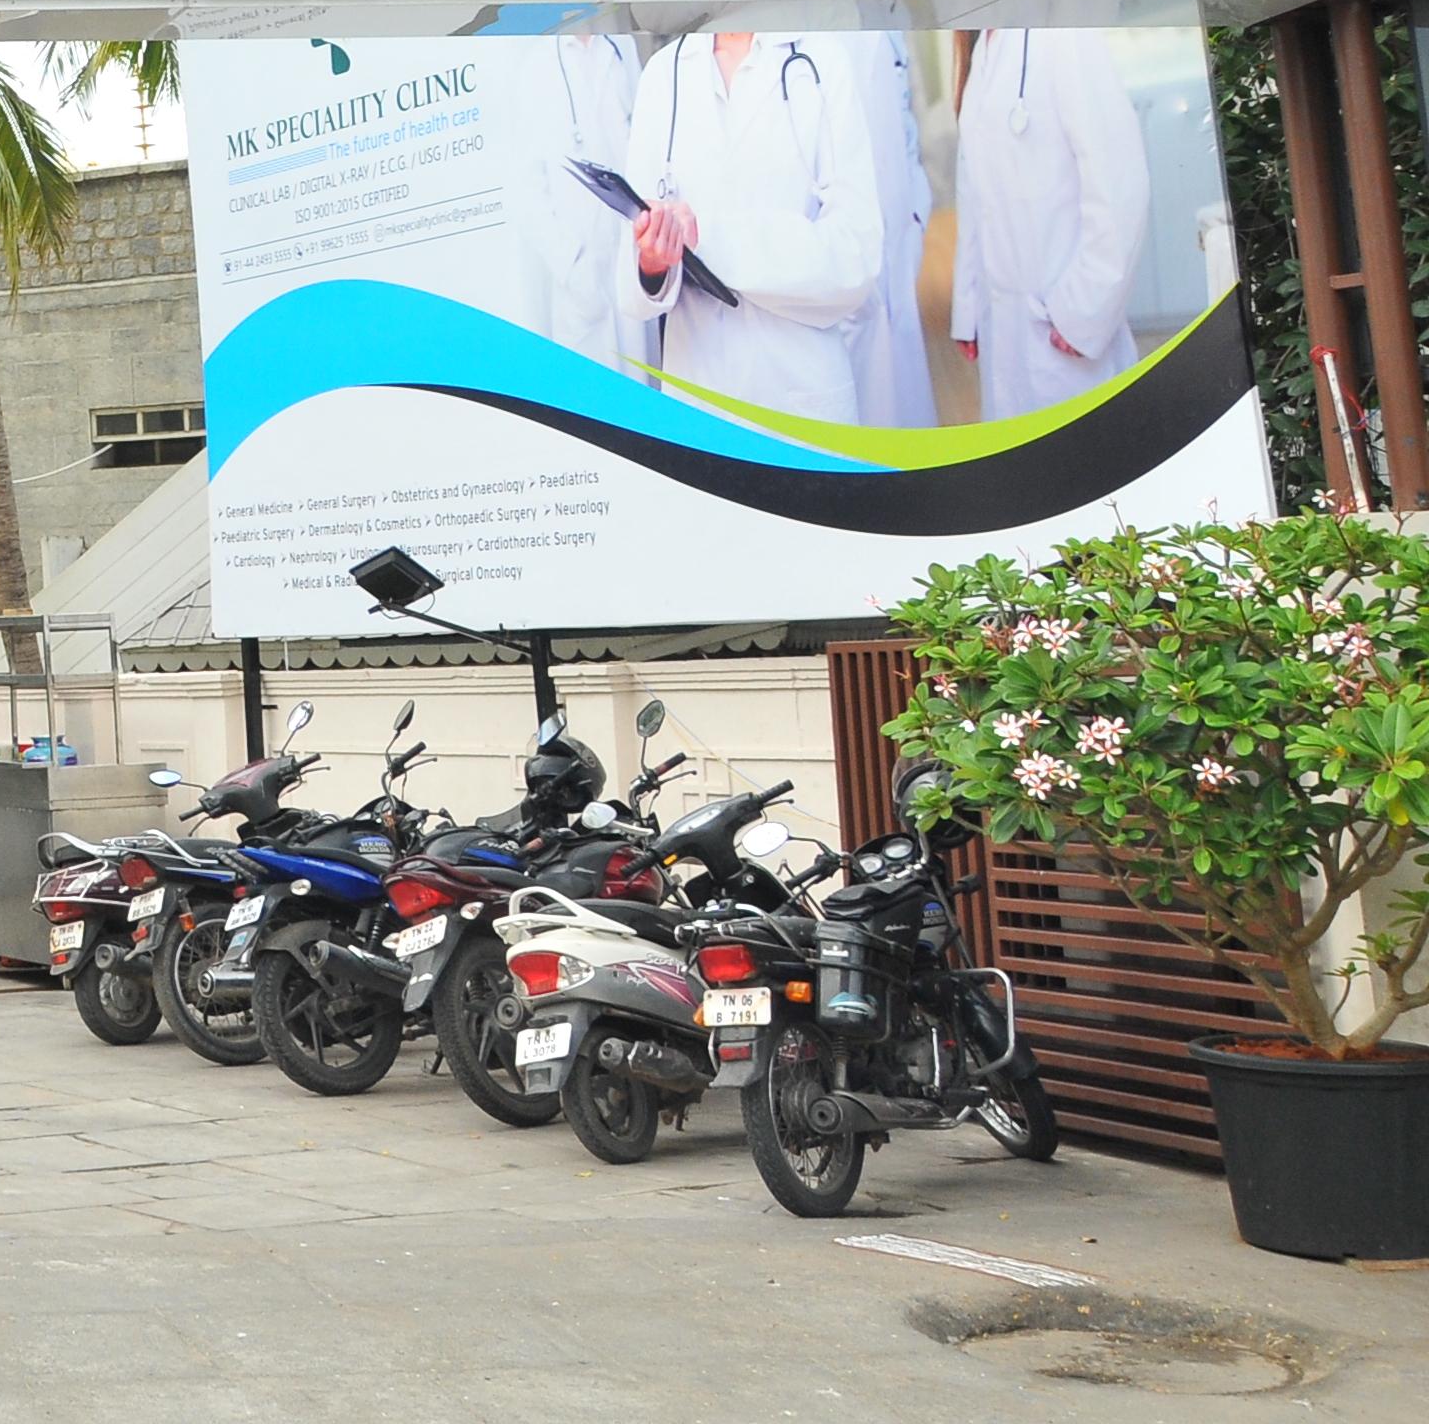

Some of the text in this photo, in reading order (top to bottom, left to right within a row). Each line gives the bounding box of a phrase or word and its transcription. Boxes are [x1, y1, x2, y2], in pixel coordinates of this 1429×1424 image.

[227, 63, 477, 161] MK SPECIALITY CLINIC
[329, 105, 481, 161] The future of health care
[229, 190, 270, 213] CLINICAL
[272, 185, 291, 204] LAB
[300, 173, 338, 196] DIGITAL
[340, 164, 371, 185] X-RAY
[419, 145, 442, 166] USG
[452, 135, 484, 157] ECHO
[295, 207, 311, 223] ISO
[362, 184, 410, 208] CERTIFIED
[225, 471, 600, 518] General Medicine General Surgery Obstetrics and Gynaecology Paediatrics
[221, 529, 261, 544] Paediatric
[262, 526, 295, 543] Surgery
[308, 519, 363, 538] Dermatology
[375, 515, 422, 533] Cosmetics
[434, 509, 494, 528] Orthopaedic
[497, 505, 537, 524] Surgery
[554, 499, 610, 517] Neurology
[233, 554, 276, 568] Cardiology
[289, 548, 338, 565] Nephrology
[476, 532, 551, 552] Cardiothoracic
[553, 529, 596, 547] Surgery
[291, 576, 324, 589] Medical
[476, 564, 523, 581] Oncology
[723, 994, 753, 1007] TN 06
[731, 1011, 759, 1023] 7191
[527, 1032, 541, 1046] TN
[532, 1045, 557, 1058] 3078
